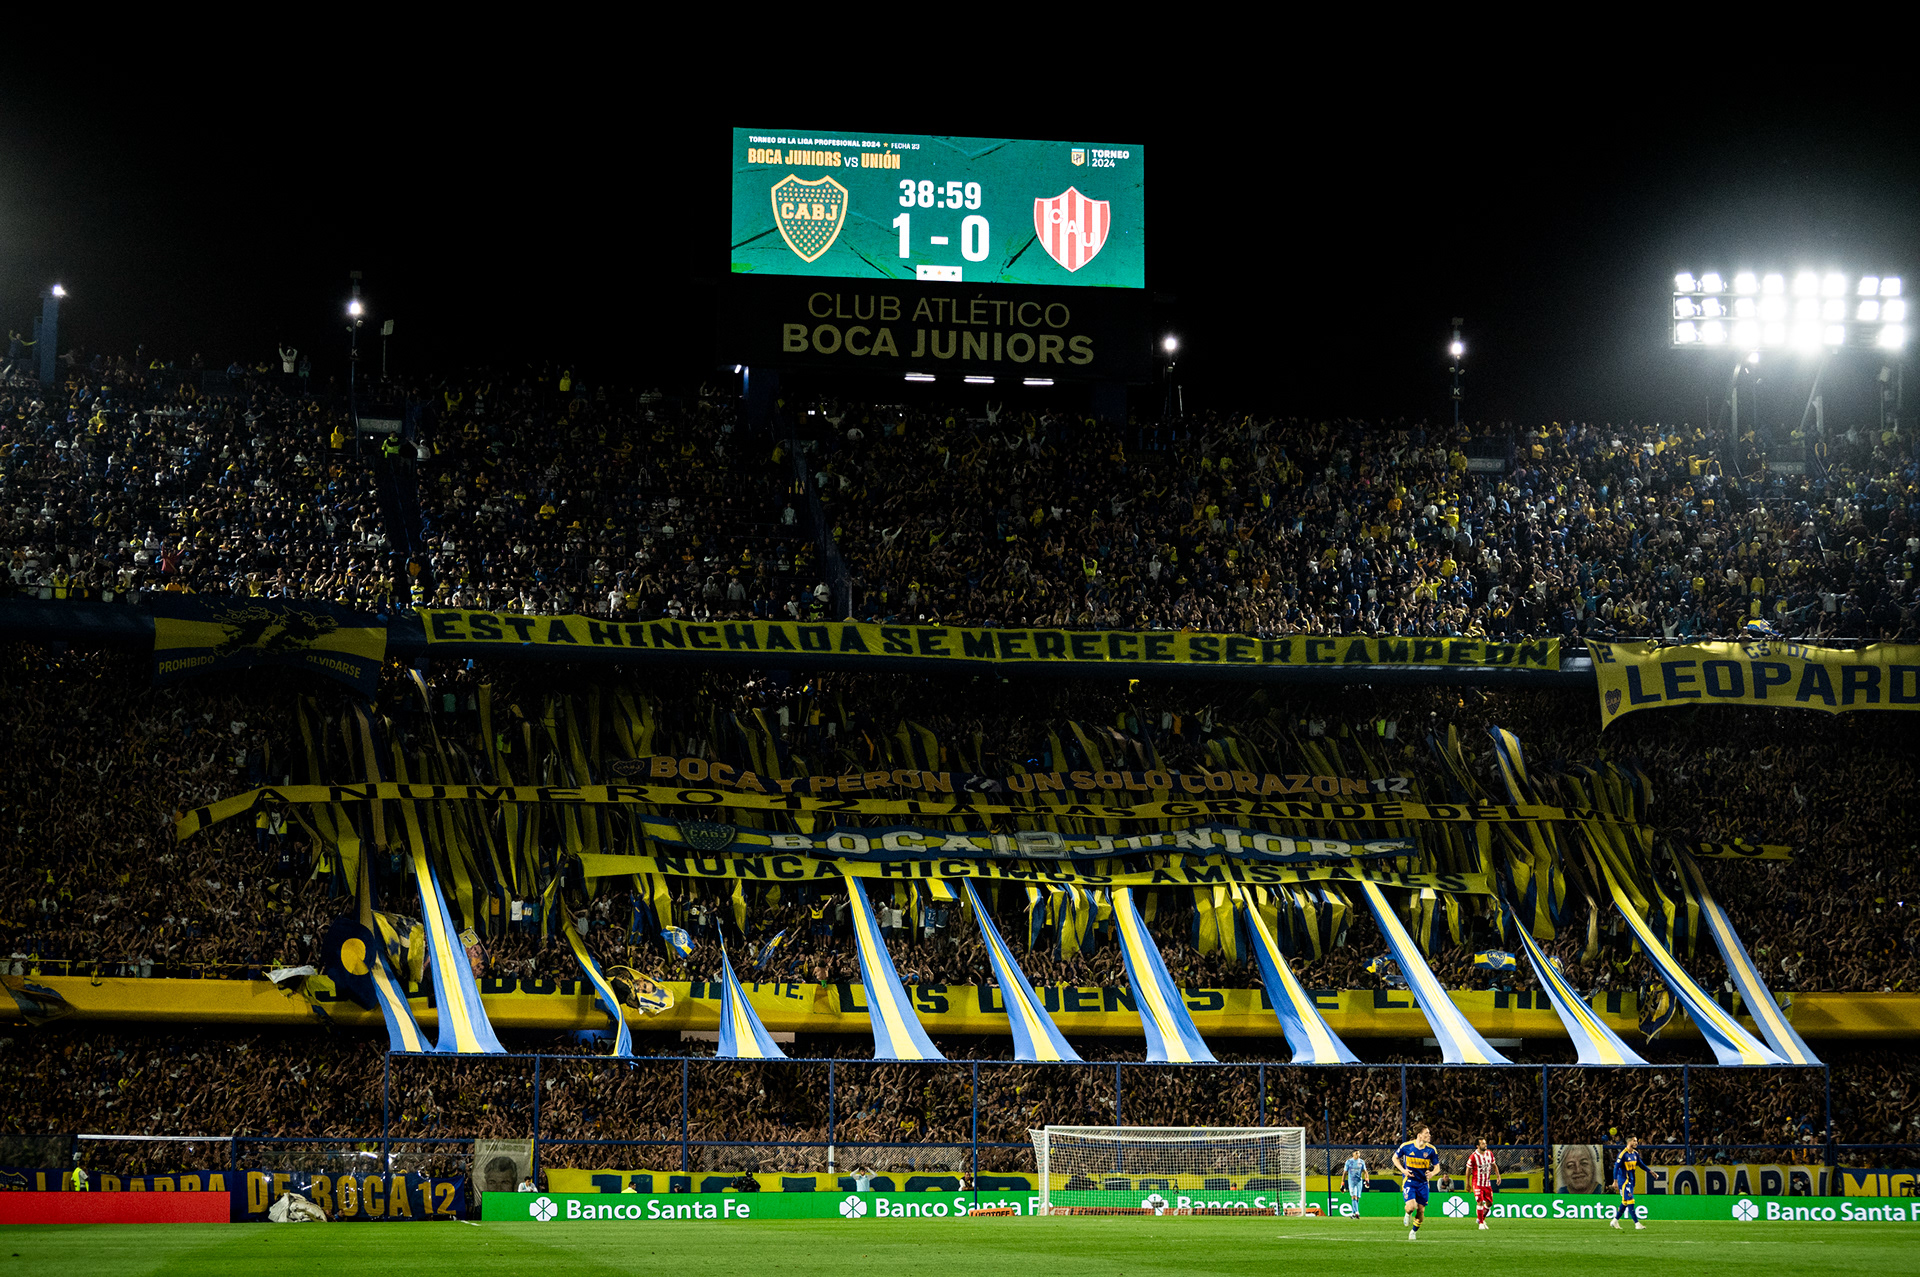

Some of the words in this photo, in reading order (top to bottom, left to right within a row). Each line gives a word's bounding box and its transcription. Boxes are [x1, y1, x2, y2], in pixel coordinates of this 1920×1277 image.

[749, 136, 776, 144] TORNEO
[787, 137, 796, 145] LA
[814, 139, 860, 147] PROFESIONAL
[891, 142, 911, 150] FECHA
[1091, 149, 1130, 159] TORNEO
[748, 148, 783, 164] BOCA
[785, 150, 842, 167] JUNIORS
[843, 157, 859, 168] VS
[861, 150, 901, 170] UNIÓN
[1091, 158, 1116, 168] 2024
[899, 179, 982, 210] 38:59
[781, 202, 838, 221] CABJ
[892, 213, 911, 259] 1
[961, 214, 990, 262] 0
[808, 292, 901, 320] CLUB
[912, 294, 1070, 329] ATLÉTICO
[783, 323, 899, 357] BOCA
[911, 329, 1094, 365] JUNIORS
[432, 613, 578, 644] ESTA
[588, 620, 869, 654] HINCHADA
[882, 628, 951, 657] SE
[963, 630, 1175, 661] MERECE
[1189, 635, 1292, 663] SER
[1305, 639, 1549, 669] CAMPEON
[1590, 643, 1616, 663] 12
[158, 655, 215, 675] PROHIBIDO
[306, 654, 361, 679] OLVIDARSE
[1625, 660, 1920, 706] LEOPARD
[650, 756, 767, 792] BOCA
[775, 777, 801, 792] Y
[1006, 772, 1066, 792] UN
[1070, 769, 1173, 791] SOLO
[1371, 778, 1411, 794] 12
[1161, 800, 1404, 818] GRANDE
[1425, 806, 1539, 820] DEL
[769, 831, 984, 854] BOCA
[656, 856, 842, 878] NUNCA
[311, 1175, 412, 1217] BOCA
[418, 1182, 456, 1216] 12
[566, 1199, 642, 1219] Banco
[647, 1199, 717, 1219] Santa
[723, 1198, 750, 1219] Fe
[876, 1198, 948, 1217] Banco
[1552, 1199, 1618, 1219] Santa
[1767, 1201, 1836, 1221] Banco
[1840, 1202, 1906, 1221] Santa
